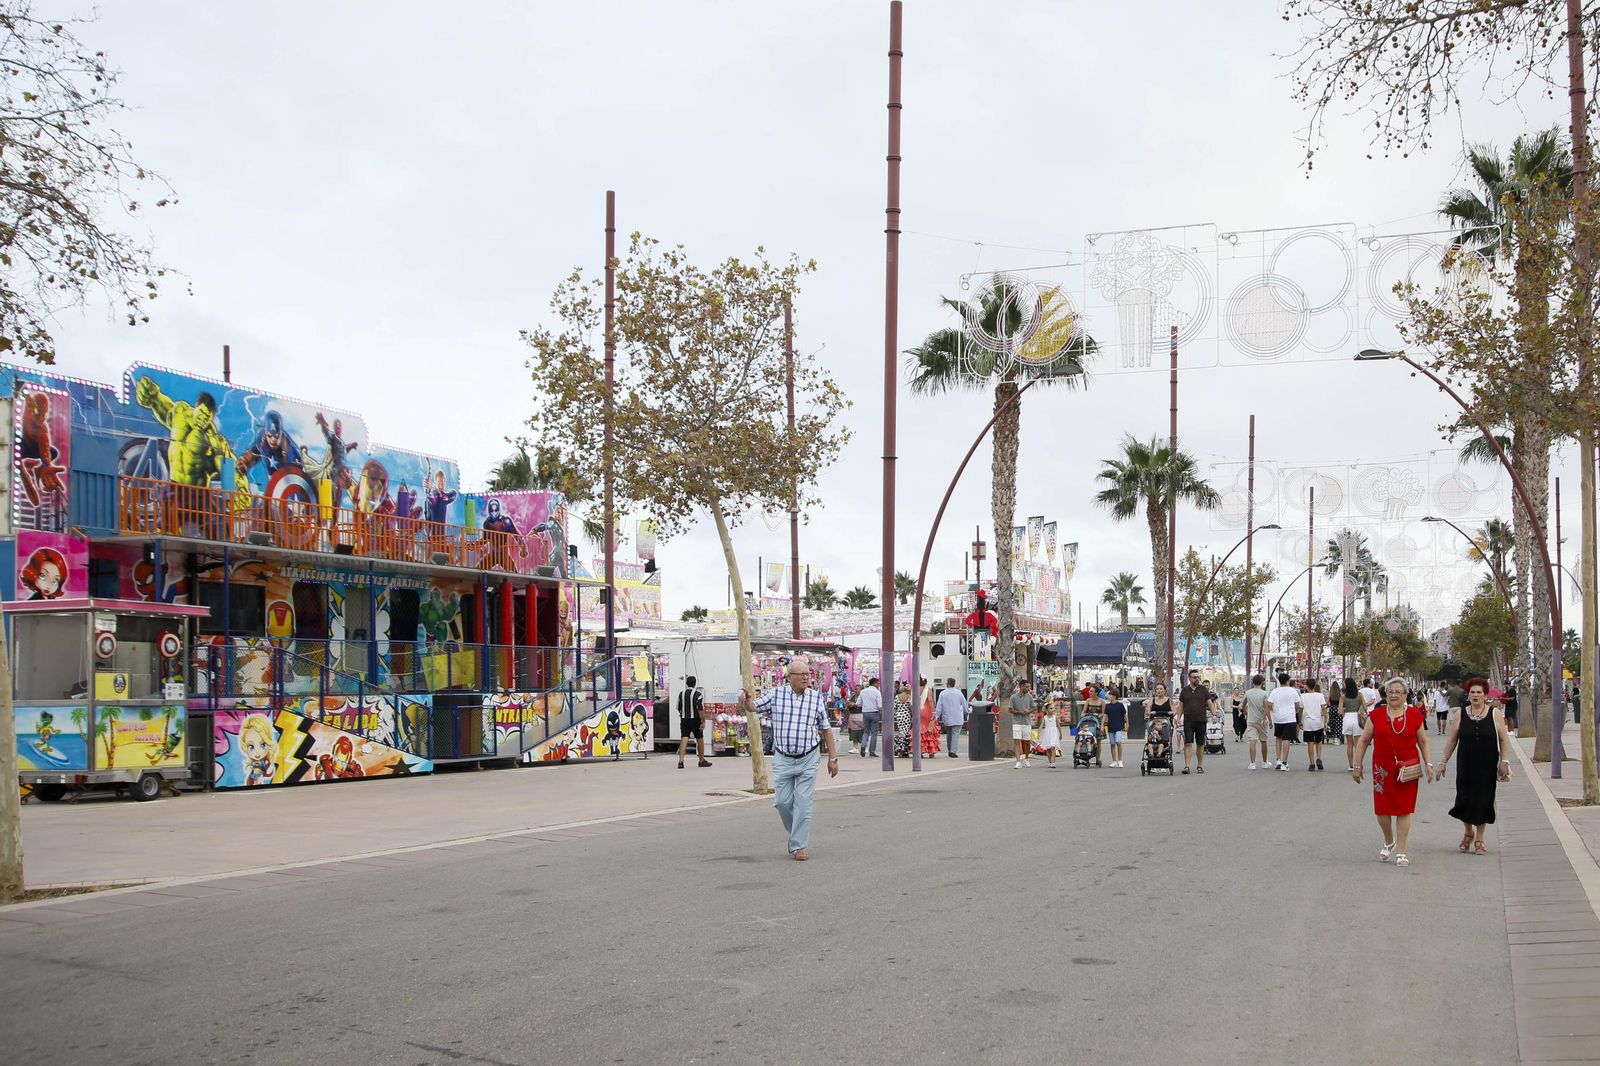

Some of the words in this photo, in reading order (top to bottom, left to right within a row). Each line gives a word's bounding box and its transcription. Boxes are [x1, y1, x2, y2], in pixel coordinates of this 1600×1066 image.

[280, 567, 345, 582] ATRACCIONES
[390, 577, 432, 589] MARTINEZ
[487, 708, 534, 724] ENTRADA
